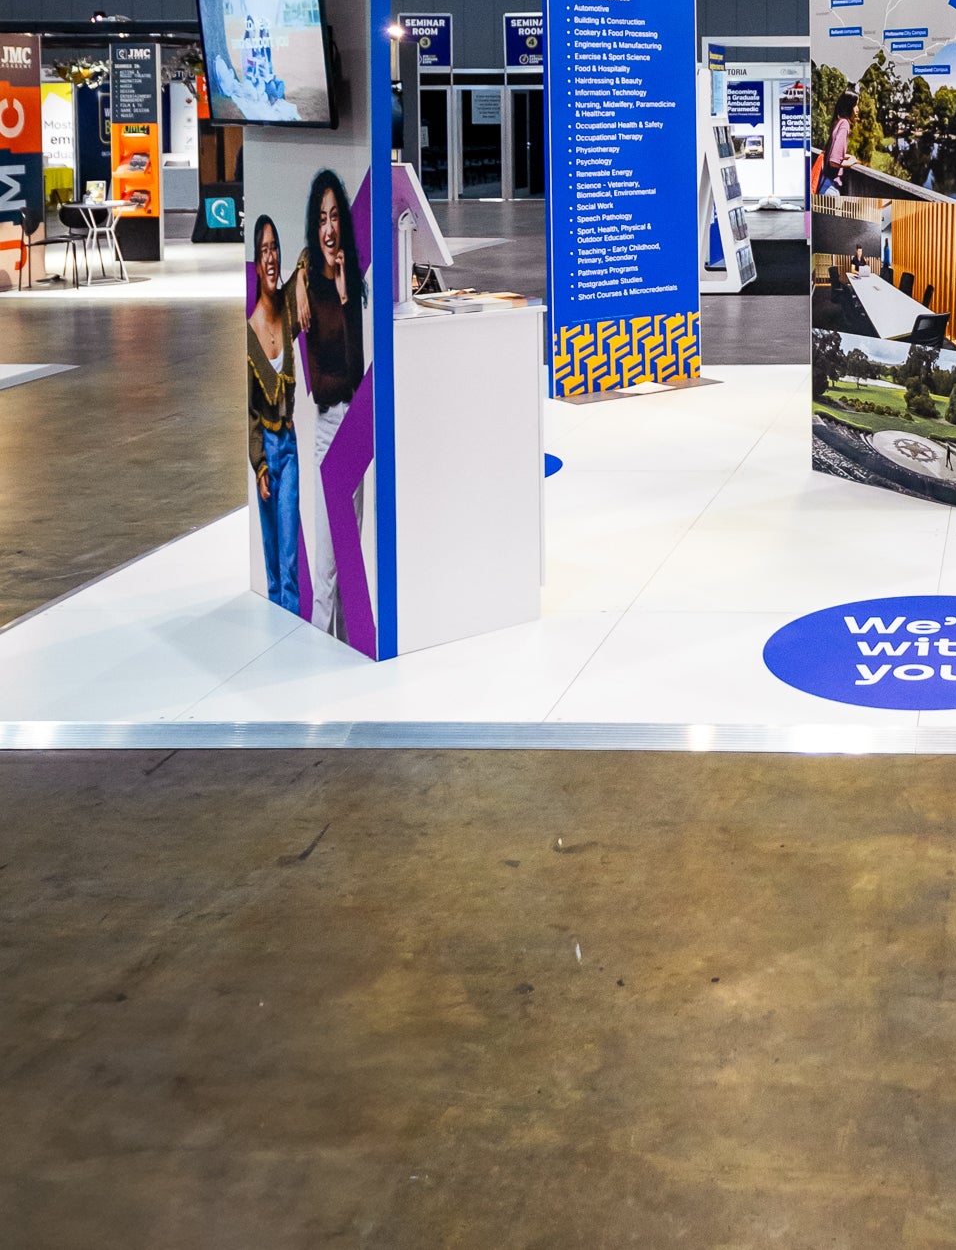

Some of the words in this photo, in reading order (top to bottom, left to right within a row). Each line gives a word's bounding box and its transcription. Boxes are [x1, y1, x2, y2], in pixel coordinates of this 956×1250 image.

[574, 16, 599, 25] Building
[574, 29, 601, 37] Cookery
[625, 30, 658, 39] Processing
[575, 41, 611, 49] Engineering
[619, 42, 662, 51] Manufacturing
[1, 46, 31, 64] JMC
[128, 49, 150, 57] JMC
[608, 53, 625, 61] Sport
[626, 53, 650, 61] Science
[598, 65, 630, 73] Hospitality
[575, 77, 614, 85] Hairdressing
[621, 77, 642, 85] Beauty
[612, 89, 647, 97] Technology
[575, 101, 601, 109] Nursing,
[603, 101, 634, 109] Midwifery,
[576, 122, 616, 130] Occupational
[618, 121, 637, 129] Health
[645, 121, 663, 129] Safety
[576, 134, 616, 142] Occupational
[618, 133, 643, 141] Therapy
[576, 146, 620, 154] Physiotherapy
[576, 158, 612, 166] Psychology
[612, 169, 633, 177] Energy
[614, 188, 656, 197] Environmental
[577, 203, 596, 211] Social
[577, 215, 601, 223] Speech
[602, 213, 632, 221] Pathology
[598, 225, 619, 233] Health,
[621, 224, 646, 232] Physical
[578, 248, 606, 256] Teaching
[612, 245, 628, 253] Early
[629, 243, 660, 251] Childhood,
[605, 254, 637, 262] Secondary
[578, 268, 608, 276] Pathways
[609, 265, 638, 273] Programs
[578, 280, 619, 288] Postgraduate
[578, 293, 595, 301] Short
[597, 291, 622, 299] Courses
[629, 285, 678, 295] Microcredentials
